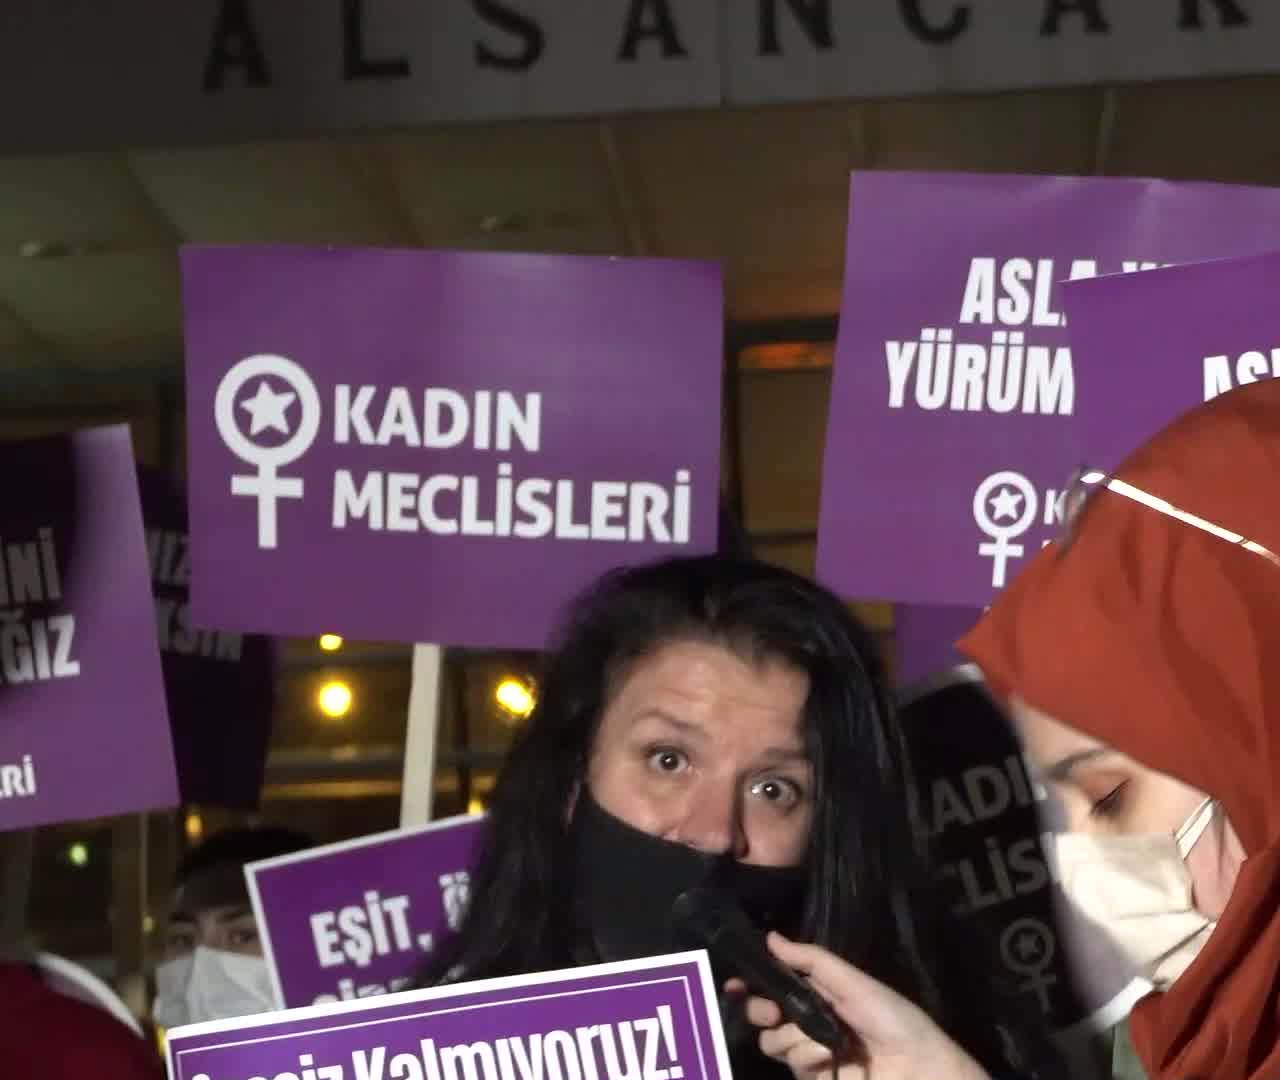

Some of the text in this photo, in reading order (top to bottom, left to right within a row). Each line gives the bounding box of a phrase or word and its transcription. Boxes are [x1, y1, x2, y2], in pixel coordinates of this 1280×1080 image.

[200, 0, 1252, 93] ALSAN
[333, 383, 543, 452] KADIN
[331, 462, 692, 544] MECLİSLERİ
